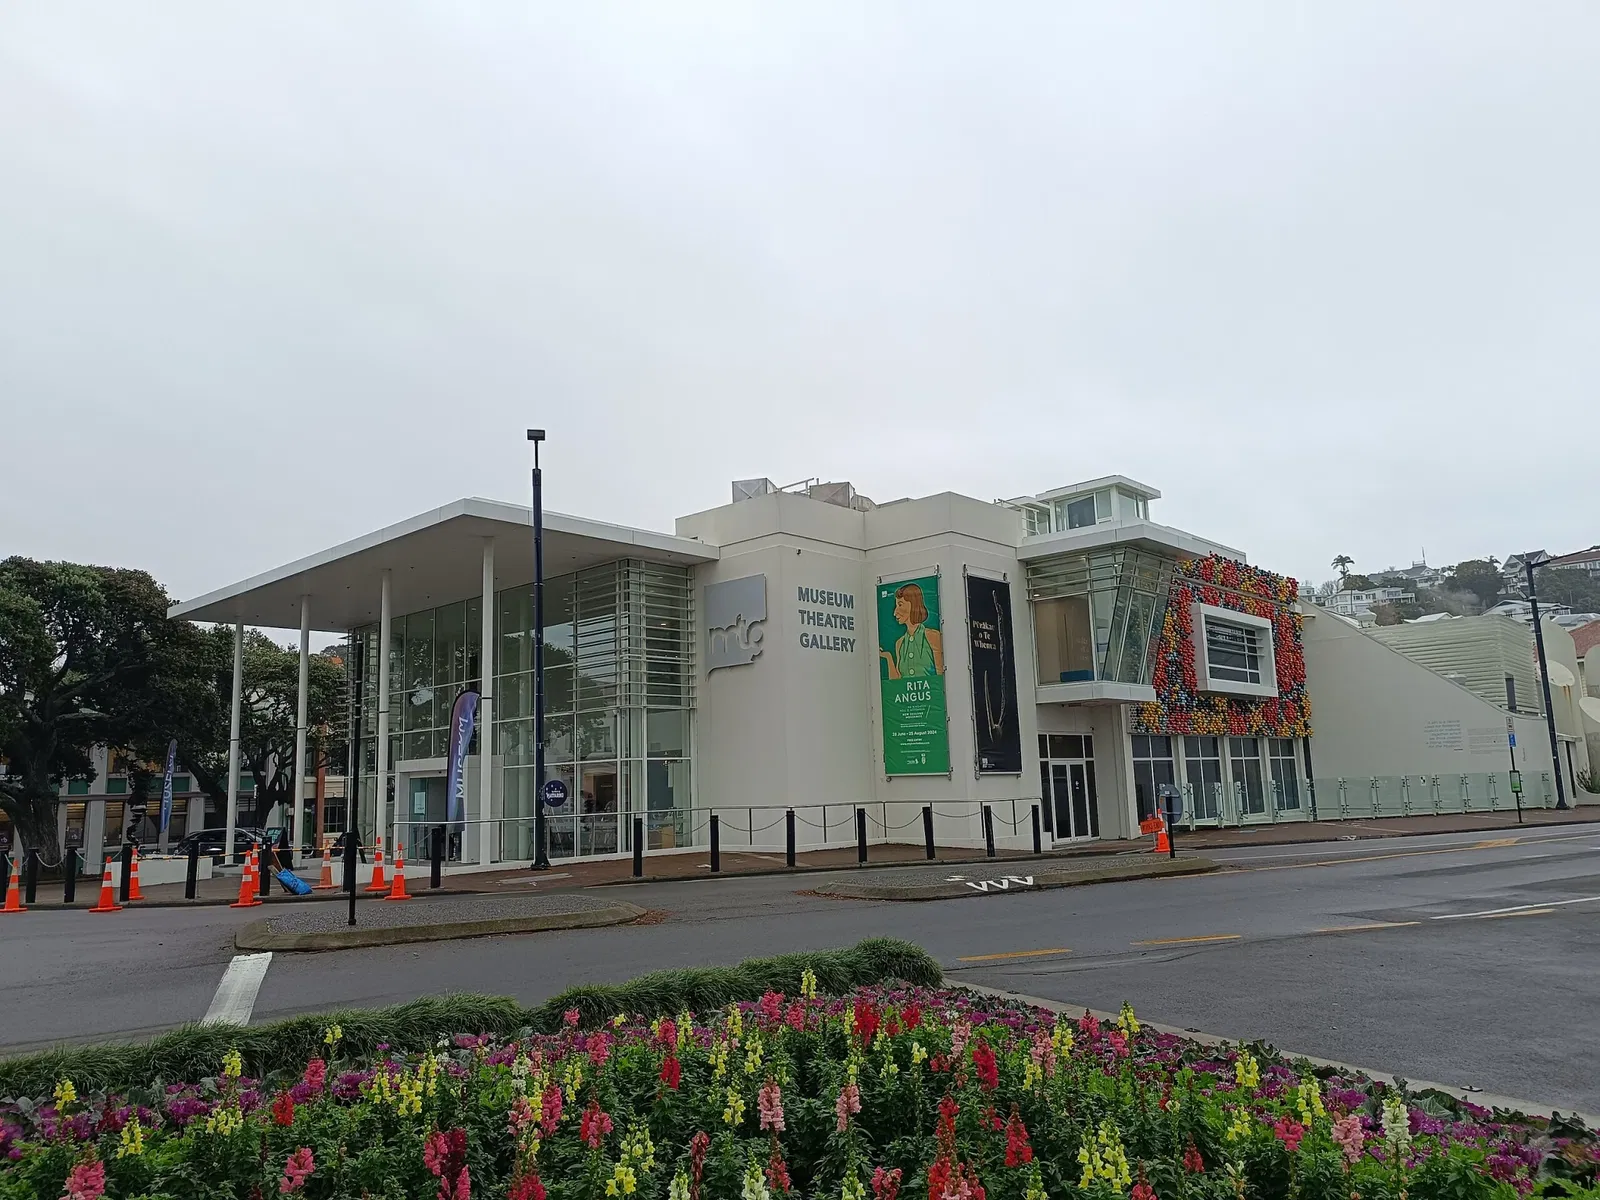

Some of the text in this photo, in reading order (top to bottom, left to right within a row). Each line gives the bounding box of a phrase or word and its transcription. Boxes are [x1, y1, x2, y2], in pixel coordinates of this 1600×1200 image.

[797, 586, 854, 610] MUSEUM
[798, 609, 855, 631] THEATRE
[799, 632, 856, 653] GALLERY
[983, 632, 990, 640] Te
[906, 680, 930, 691] RITA
[894, 691, 931, 703] ANGUS
